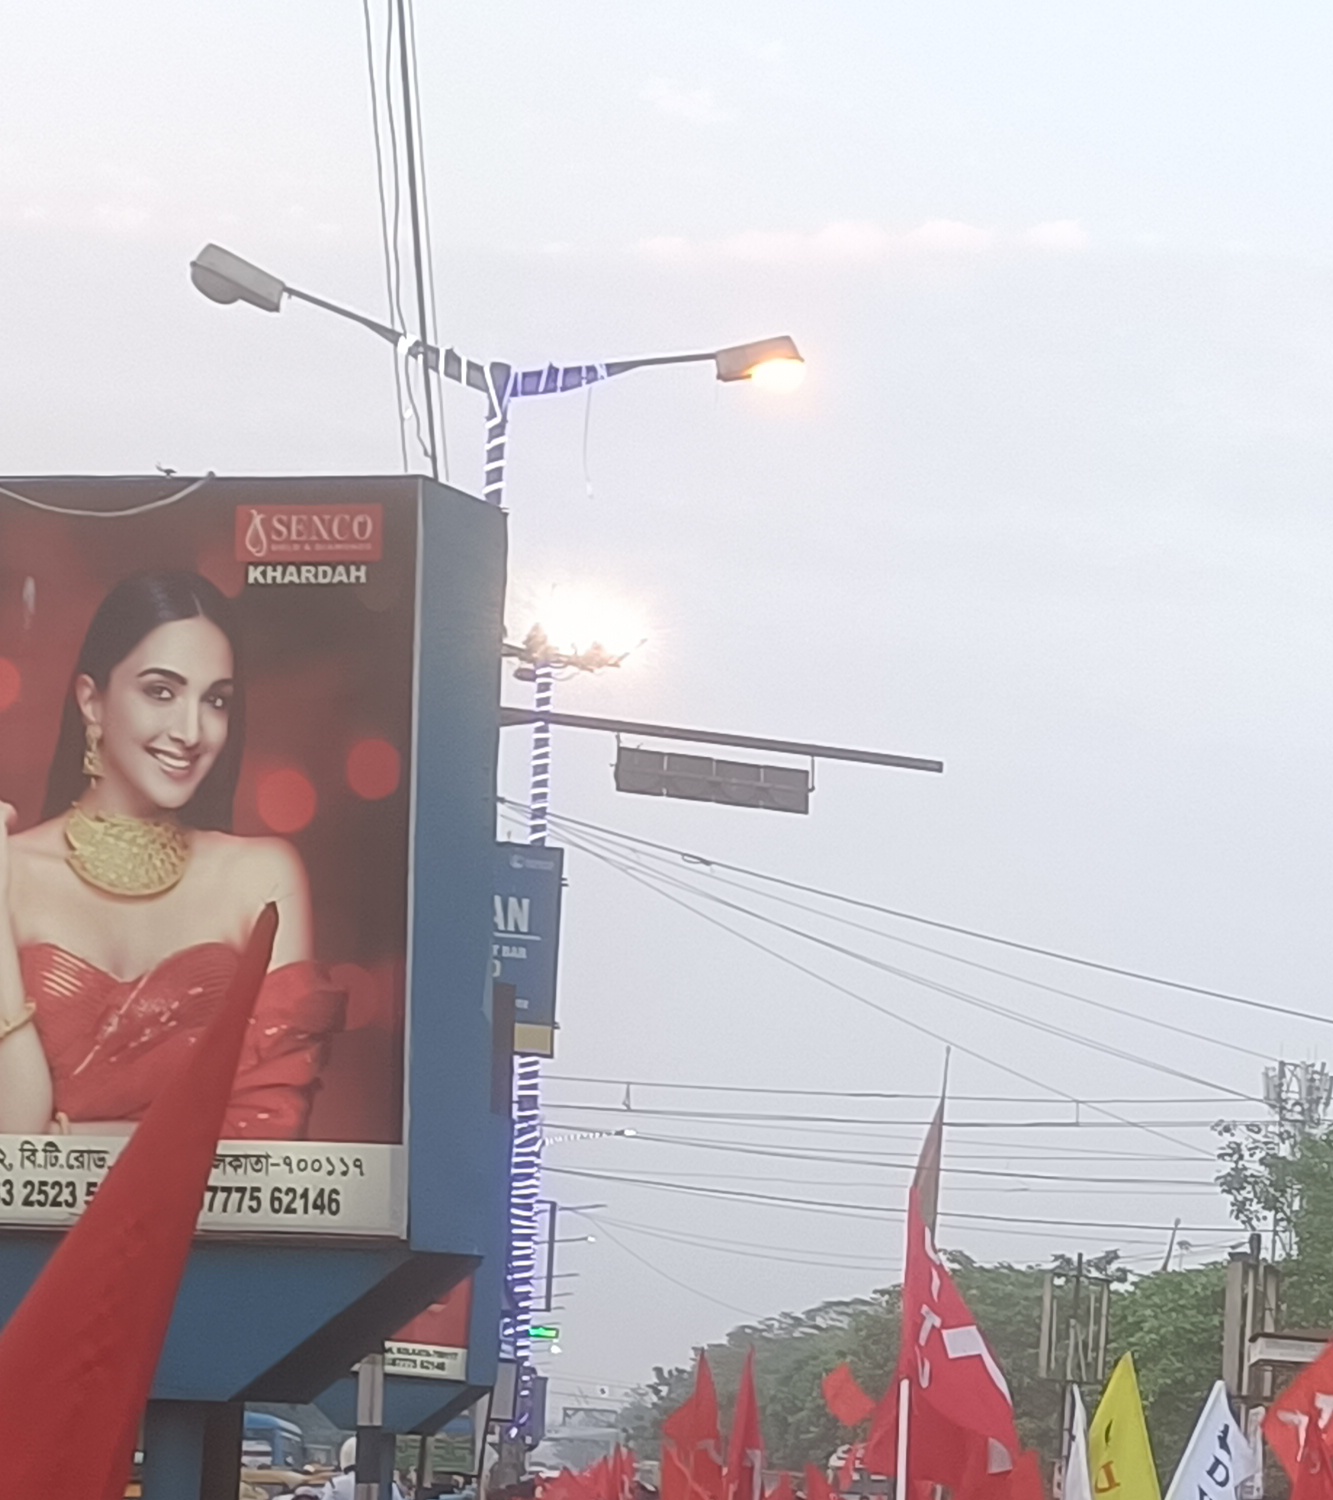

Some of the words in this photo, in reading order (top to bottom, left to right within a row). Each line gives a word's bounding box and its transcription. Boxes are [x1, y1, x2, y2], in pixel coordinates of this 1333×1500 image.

[270, 514, 373, 541] SENCO
[247, 565, 367, 584] KHARDAH
[22, 1180, 78, 1208] 2523
[205, 1186, 262, 1215] 7775
[269, 1186, 341, 1216] 62146
